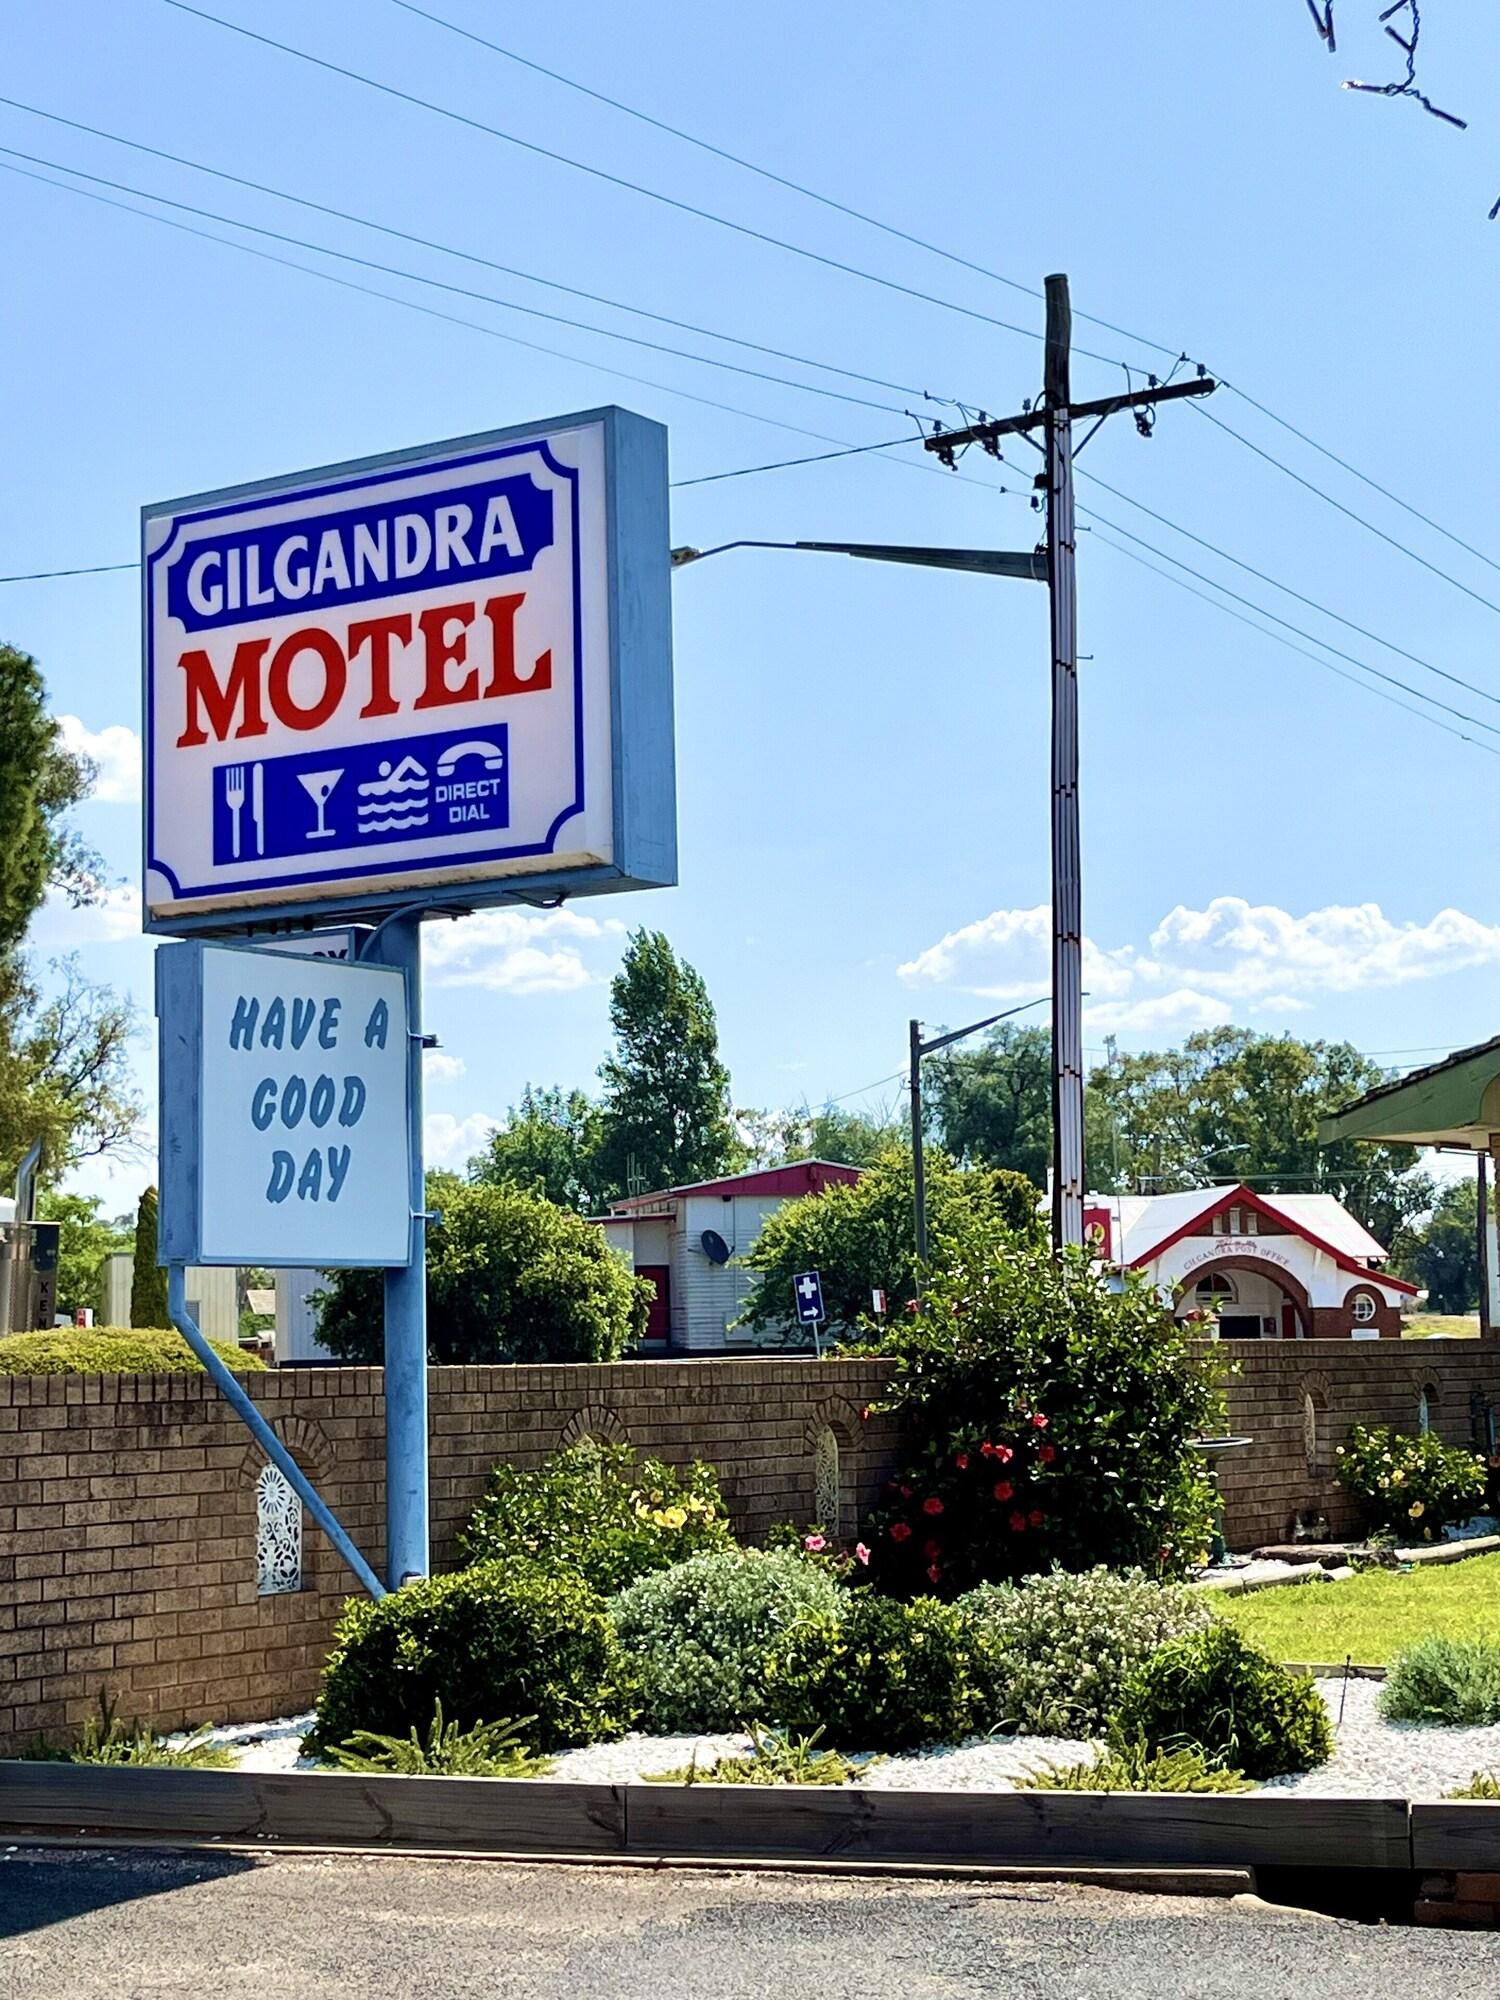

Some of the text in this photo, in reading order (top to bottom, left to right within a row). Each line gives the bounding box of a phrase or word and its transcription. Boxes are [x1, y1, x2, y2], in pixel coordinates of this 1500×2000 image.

[187, 495, 525, 616] GILGANDRA
[176, 592, 552, 748] MOTEL
[435, 778, 501, 803] DIRECT
[449, 803, 490, 823] DIAL
[230, 996, 388, 1051] HAVE A
[251, 1074, 366, 1131] GOOD
[266, 1145, 351, 1203] DAY
